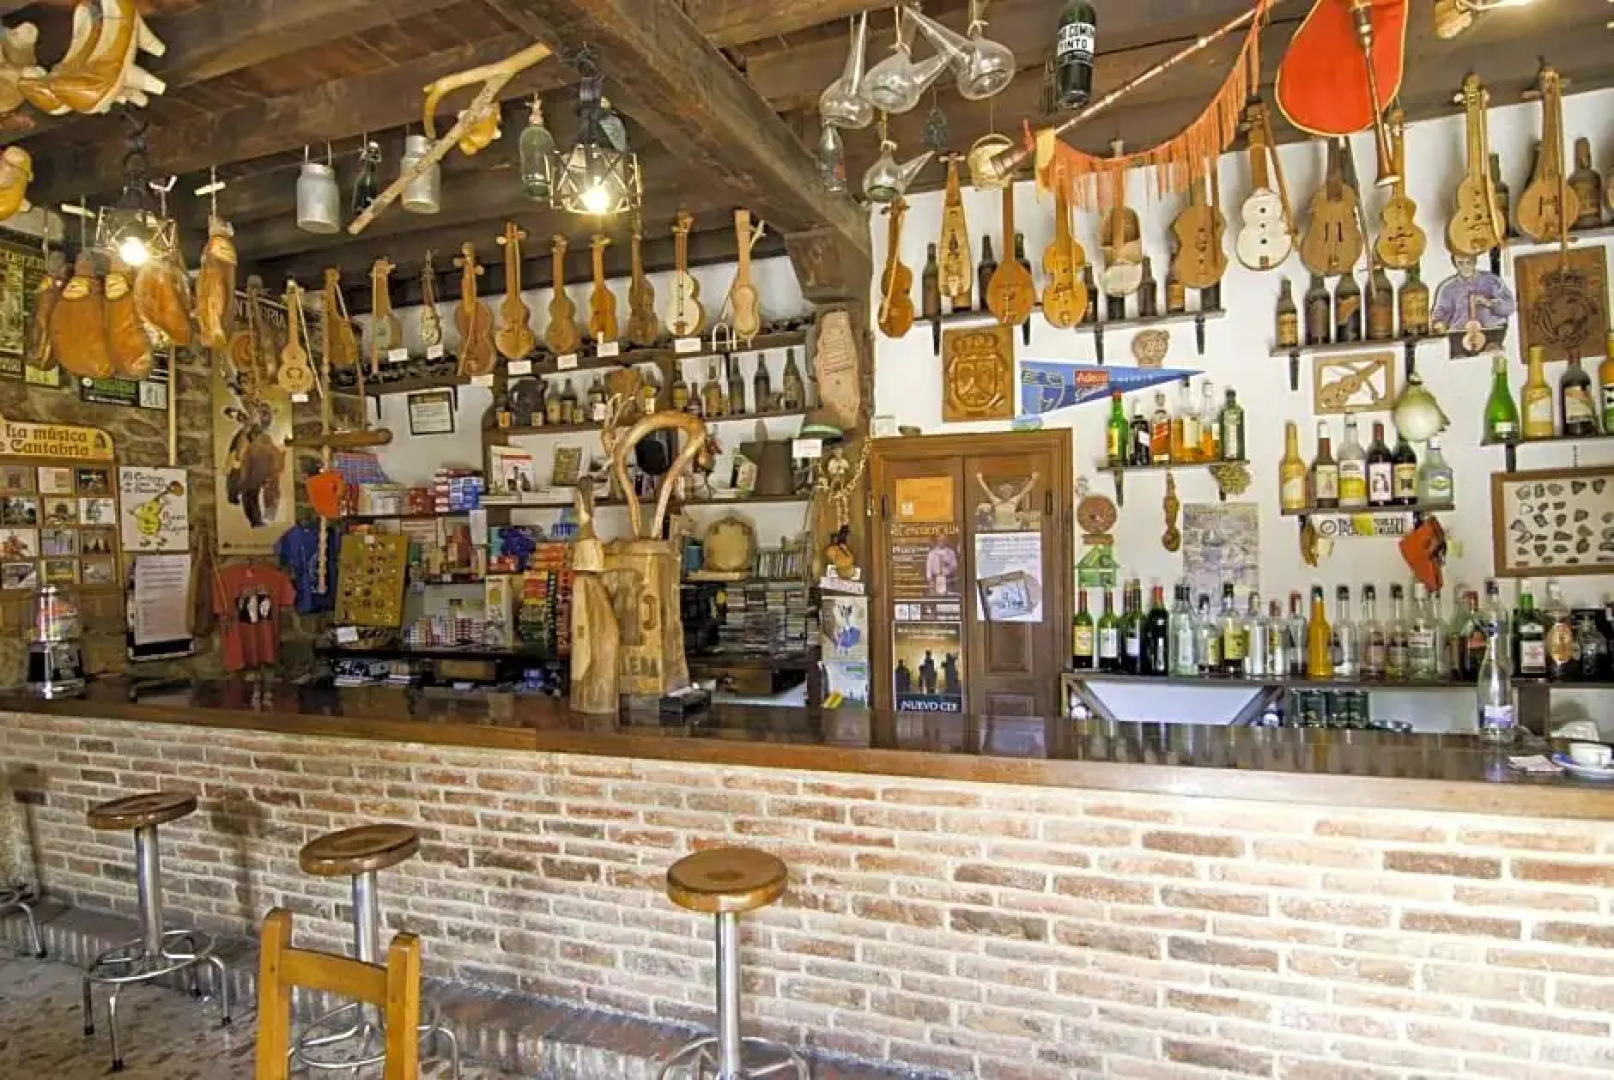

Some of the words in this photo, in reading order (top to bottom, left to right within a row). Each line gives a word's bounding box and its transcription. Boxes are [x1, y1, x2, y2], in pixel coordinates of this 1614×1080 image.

[5, 423, 27, 439] La
[33, 427, 87, 442] música
[10, 439, 89, 455] Cantabria
